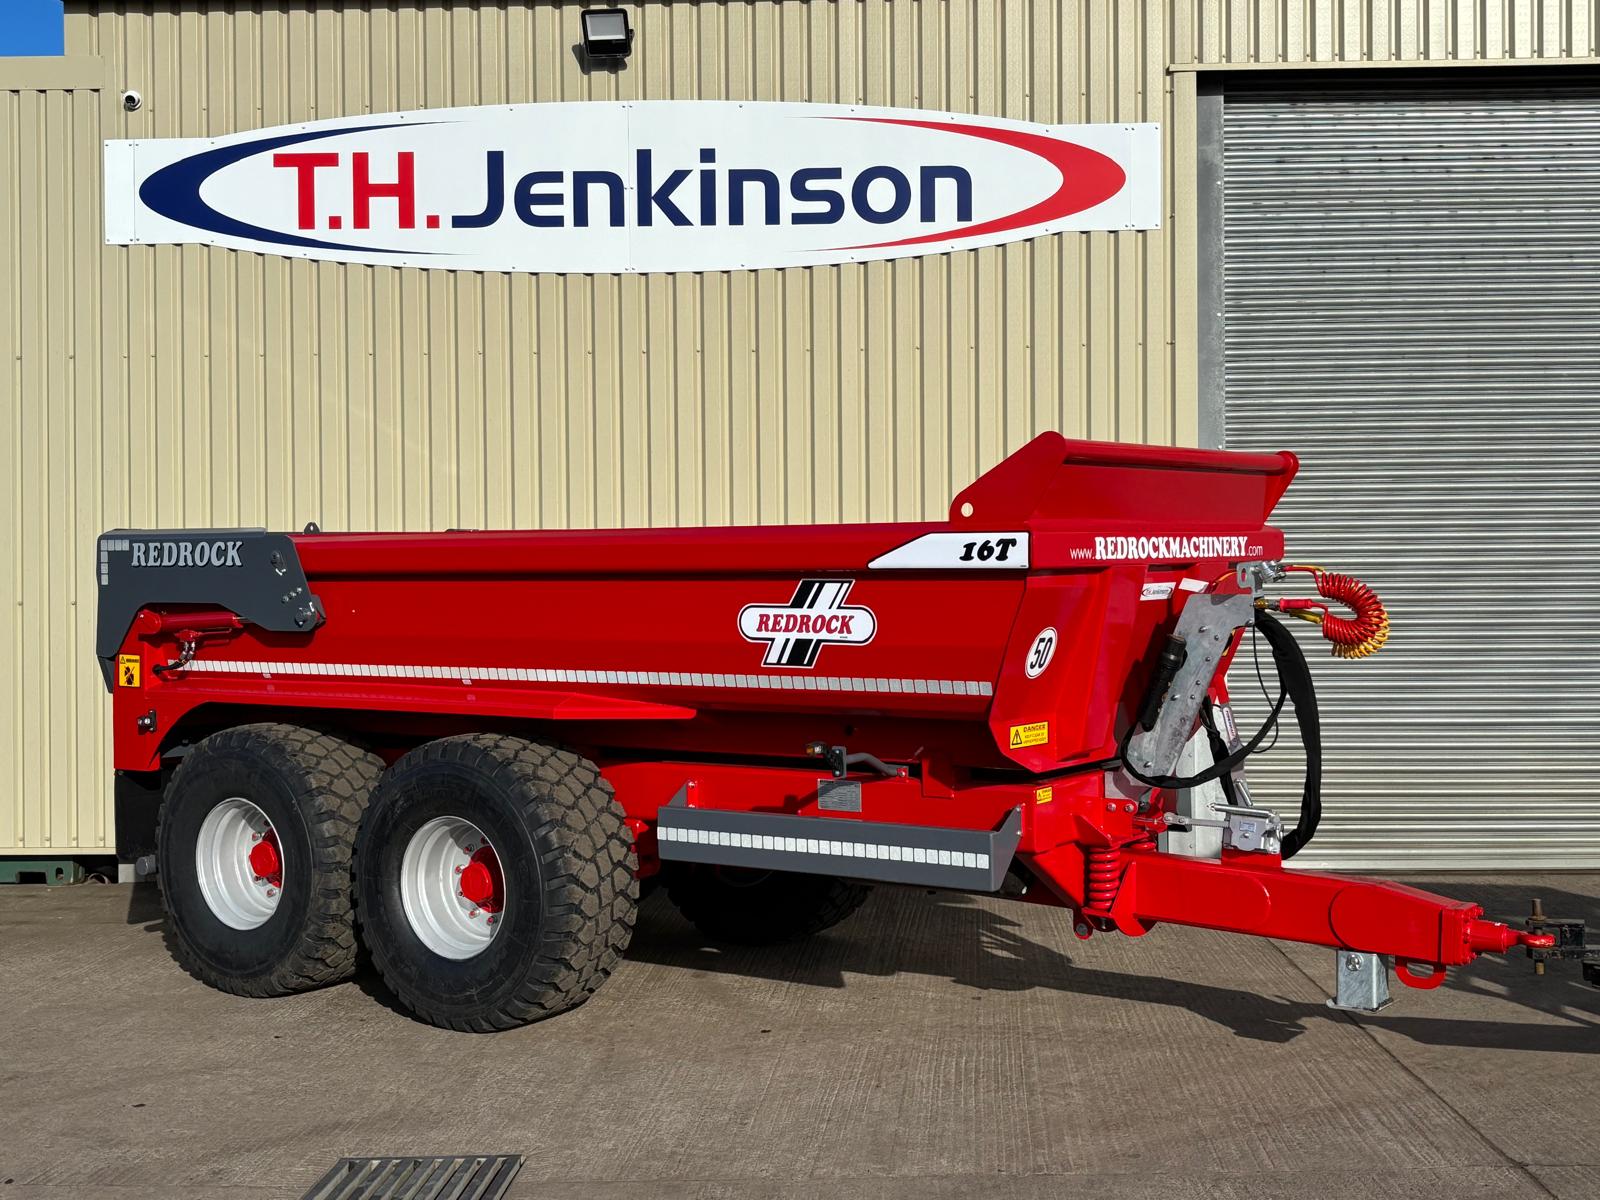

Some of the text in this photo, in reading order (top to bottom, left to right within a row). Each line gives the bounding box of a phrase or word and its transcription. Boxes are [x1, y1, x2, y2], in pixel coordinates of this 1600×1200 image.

[273, 148, 973, 230] T.H. Jenkinson
[131, 541, 243, 567] REDROCK
[959, 538, 1017, 561] 16T
[1069, 536, 1264, 561] www.REDROCKMACHINERY.com
[756, 613, 855, 635] REDROCK
[1030, 637, 1053, 669] 50
